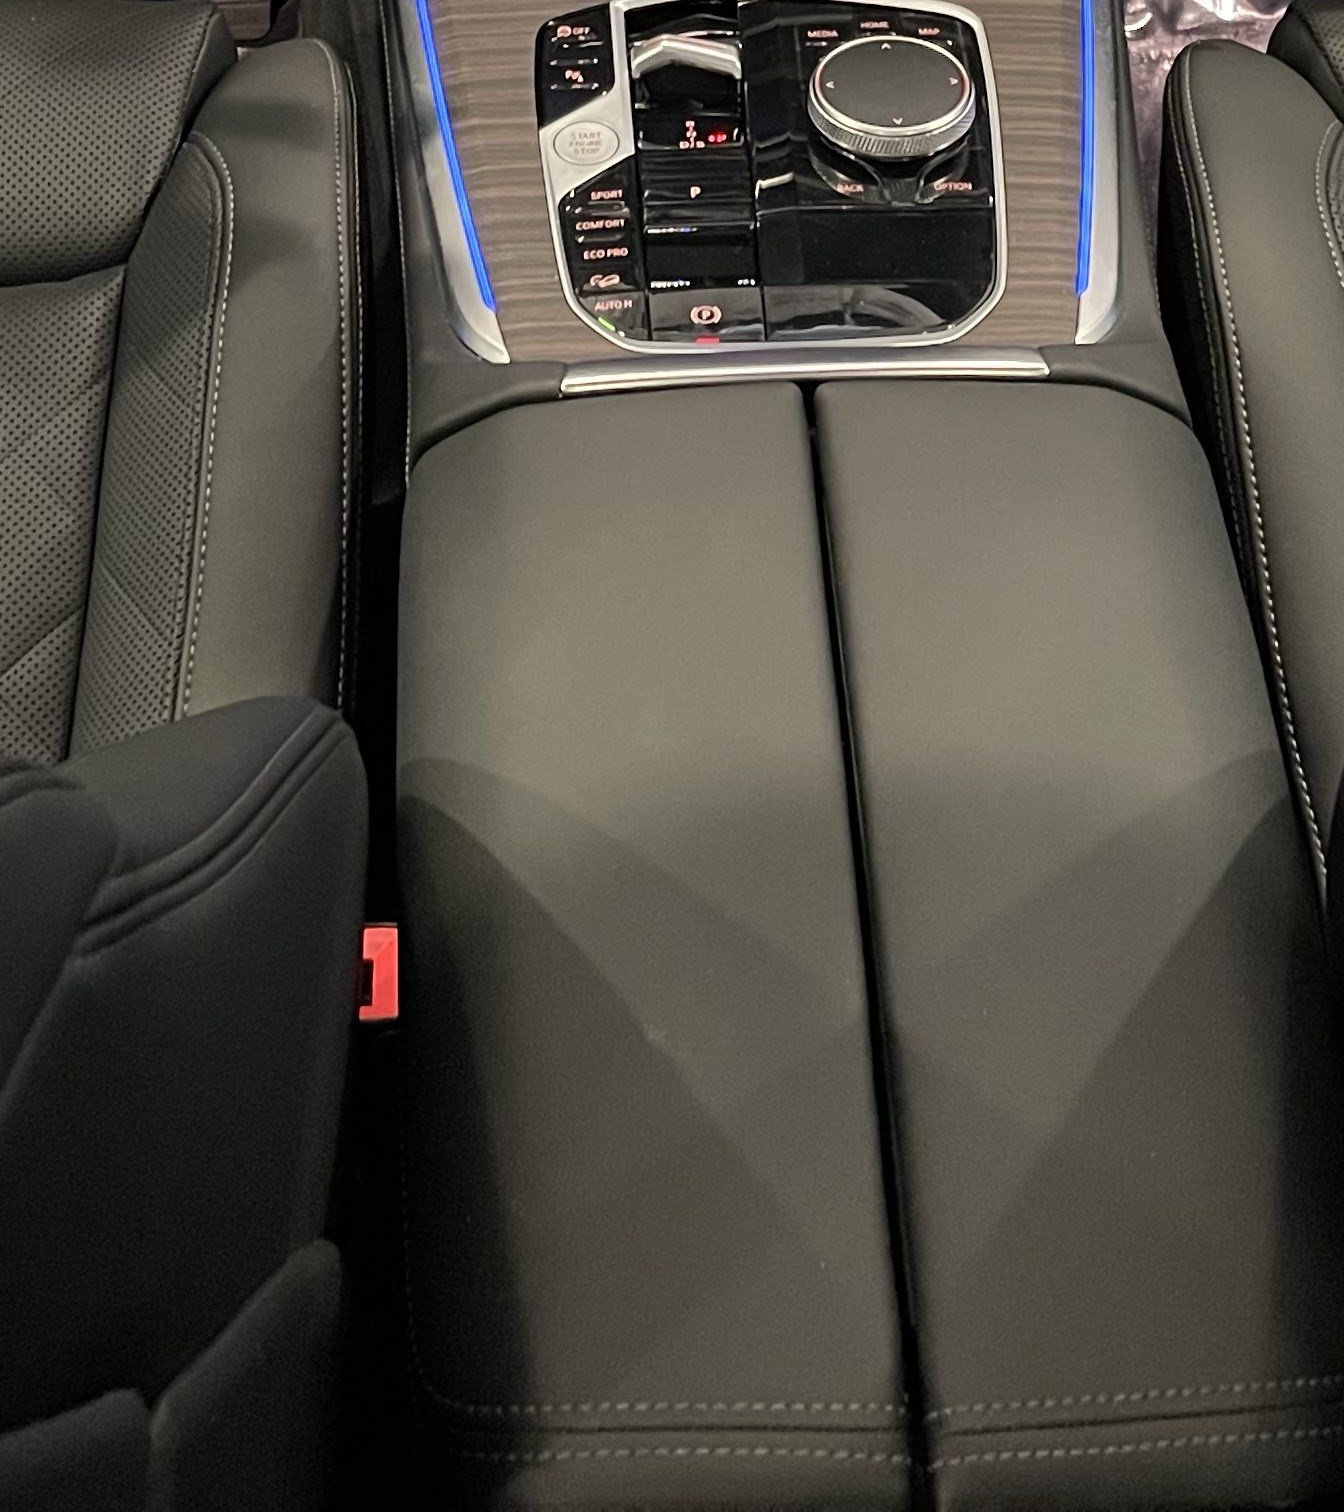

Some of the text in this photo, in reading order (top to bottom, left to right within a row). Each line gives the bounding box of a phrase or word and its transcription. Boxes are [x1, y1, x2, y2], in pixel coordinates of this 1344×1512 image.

[860, 21, 889, 29] HOME
[807, 29, 838, 38] MEDIA
[918, 27, 940, 35] MAP
[570, 131, 602, 140] START
[573, 147, 601, 155] STOP
[836, 183, 864, 193] BACK
[934, 182, 973, 191] OPTION
[591, 189, 623, 201] SPORT
[690, 186, 701, 199] P
[575, 218, 625, 231] COMFORT
[583, 247, 629, 260] ECO PRO
[594, 299, 622, 312] AUTO
